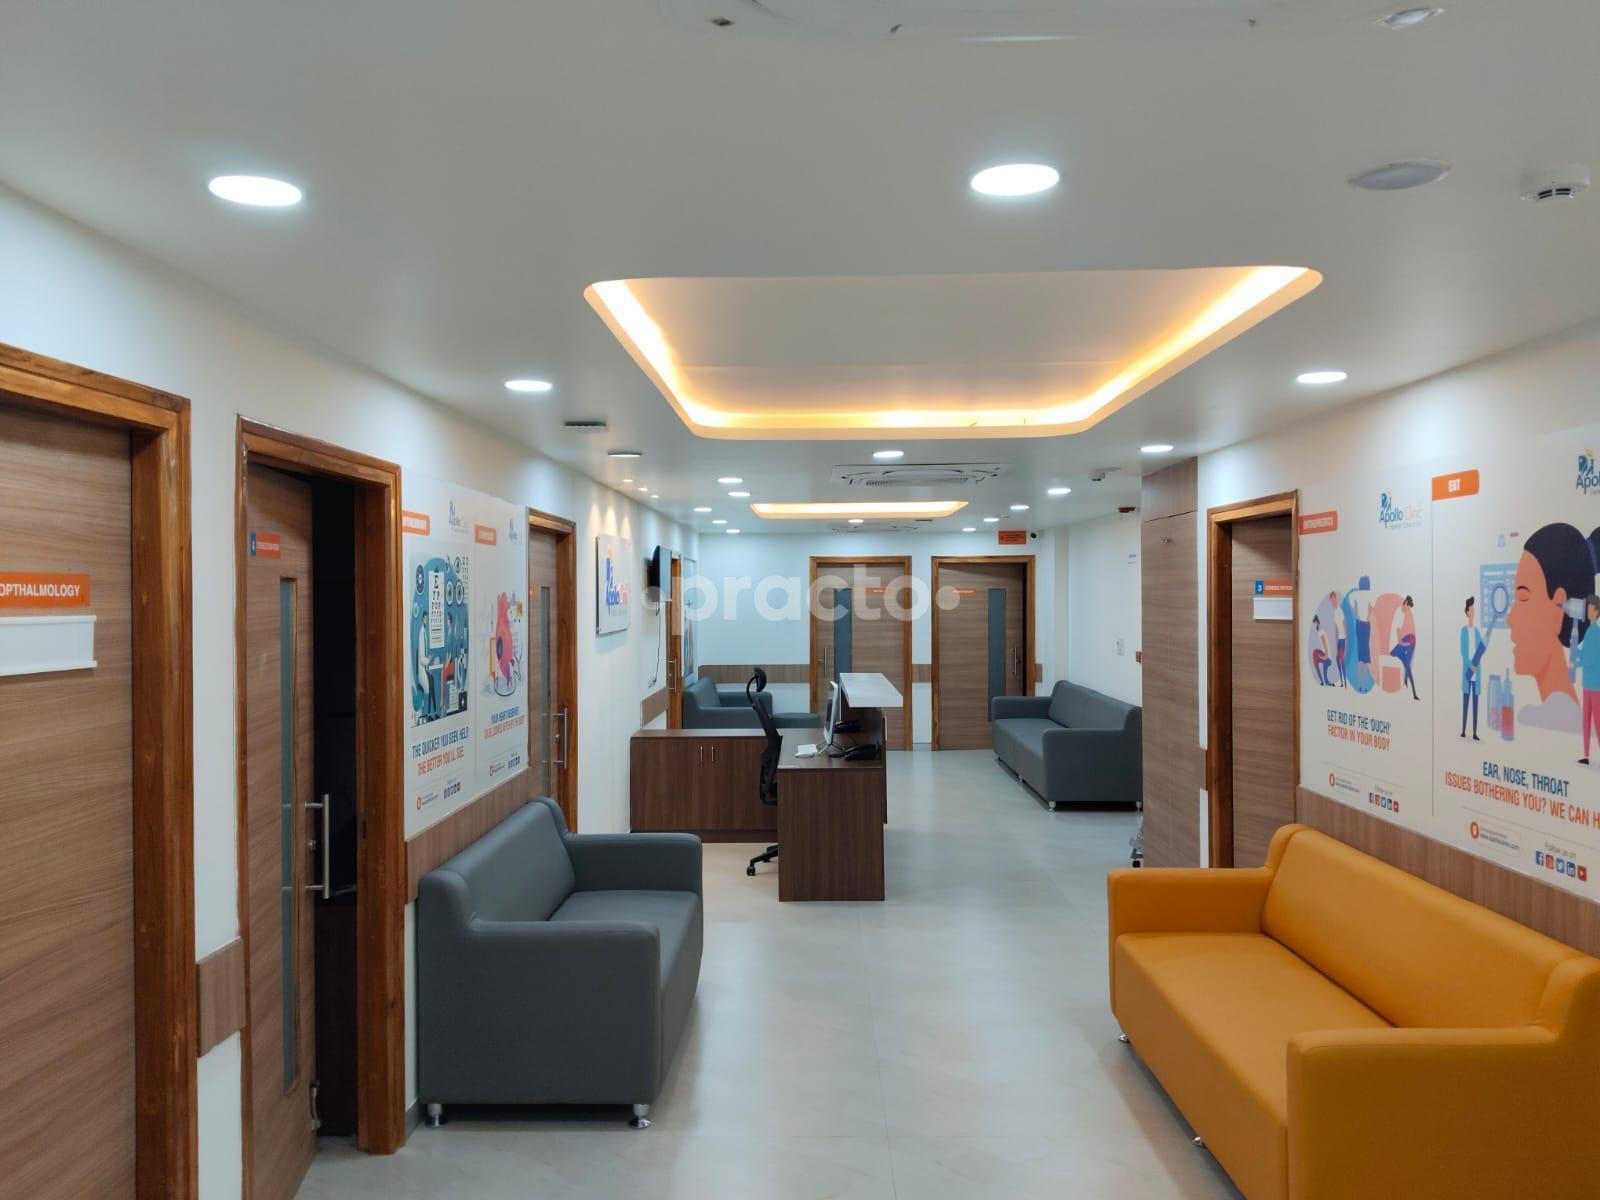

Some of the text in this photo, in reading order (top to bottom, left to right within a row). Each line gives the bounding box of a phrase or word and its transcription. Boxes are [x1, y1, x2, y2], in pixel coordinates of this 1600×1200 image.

[1448, 478, 1461, 492] ENT
[1379, 507, 1403, 528] Apollo
[0, 583, 80, 597] OPTHALMOLOGY
[1327, 709, 1337, 722] GET
[1338, 711, 1348, 724] RID
[1349, 713, 1356, 727] OF
[1358, 716, 1368, 729] THE
[1328, 724, 1390, 751] FACTOR IN YOUR BODY
[412, 744, 421, 760] THE
[427, 754, 442, 773] BETTER
[1503, 766, 1528, 789] NOSE,
[1531, 773, 1570, 797] THROAT
[1445, 771, 1471, 791] ISSUES
[1474, 779, 1520, 806] BOTHERING
[1523, 792, 1546, 813] YOU?
[1550, 800, 1565, 819] WE
[1568, 805, 1589, 826] CAN
